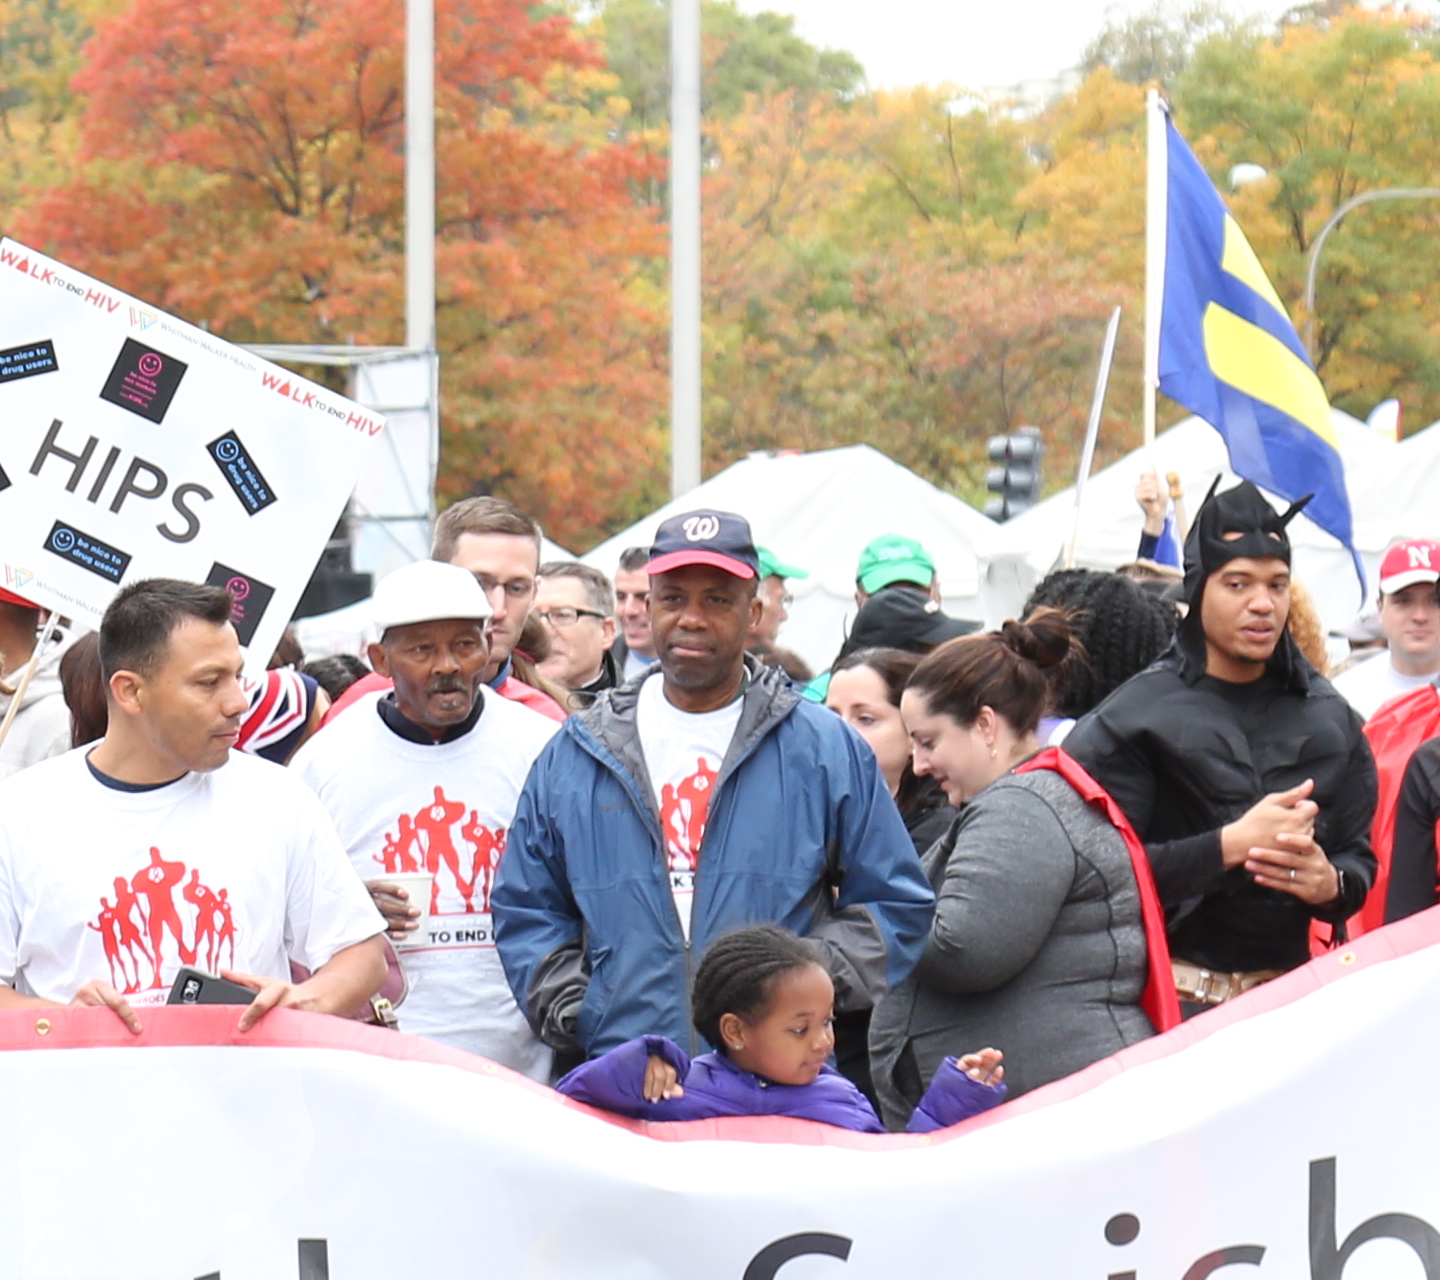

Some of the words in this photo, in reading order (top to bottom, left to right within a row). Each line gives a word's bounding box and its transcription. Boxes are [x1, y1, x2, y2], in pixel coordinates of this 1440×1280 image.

[84, 288, 121, 314] HIV
[1, 363, 25, 377] drug
[25, 358, 53, 371] users
[13, 350, 35, 362] nice
[35, 347, 47, 357] to
[345, 411, 383, 436] HIV
[28, 418, 214, 544] HIPS
[227, 464, 242, 488] drug
[240, 485, 259, 510] users
[236, 456, 246, 470] be
[244, 469, 260, 492] nice
[257, 488, 267, 501] to
[72, 548, 94, 566] drug
[94, 559, 120, 576] users
[76, 537, 90, 549] be
[90, 543, 112, 558] nice
[111, 554, 122, 565] to
[1408, 546, 1432, 568] N
[429, 931, 451, 944] TO
[456, 929, 487, 943] END
